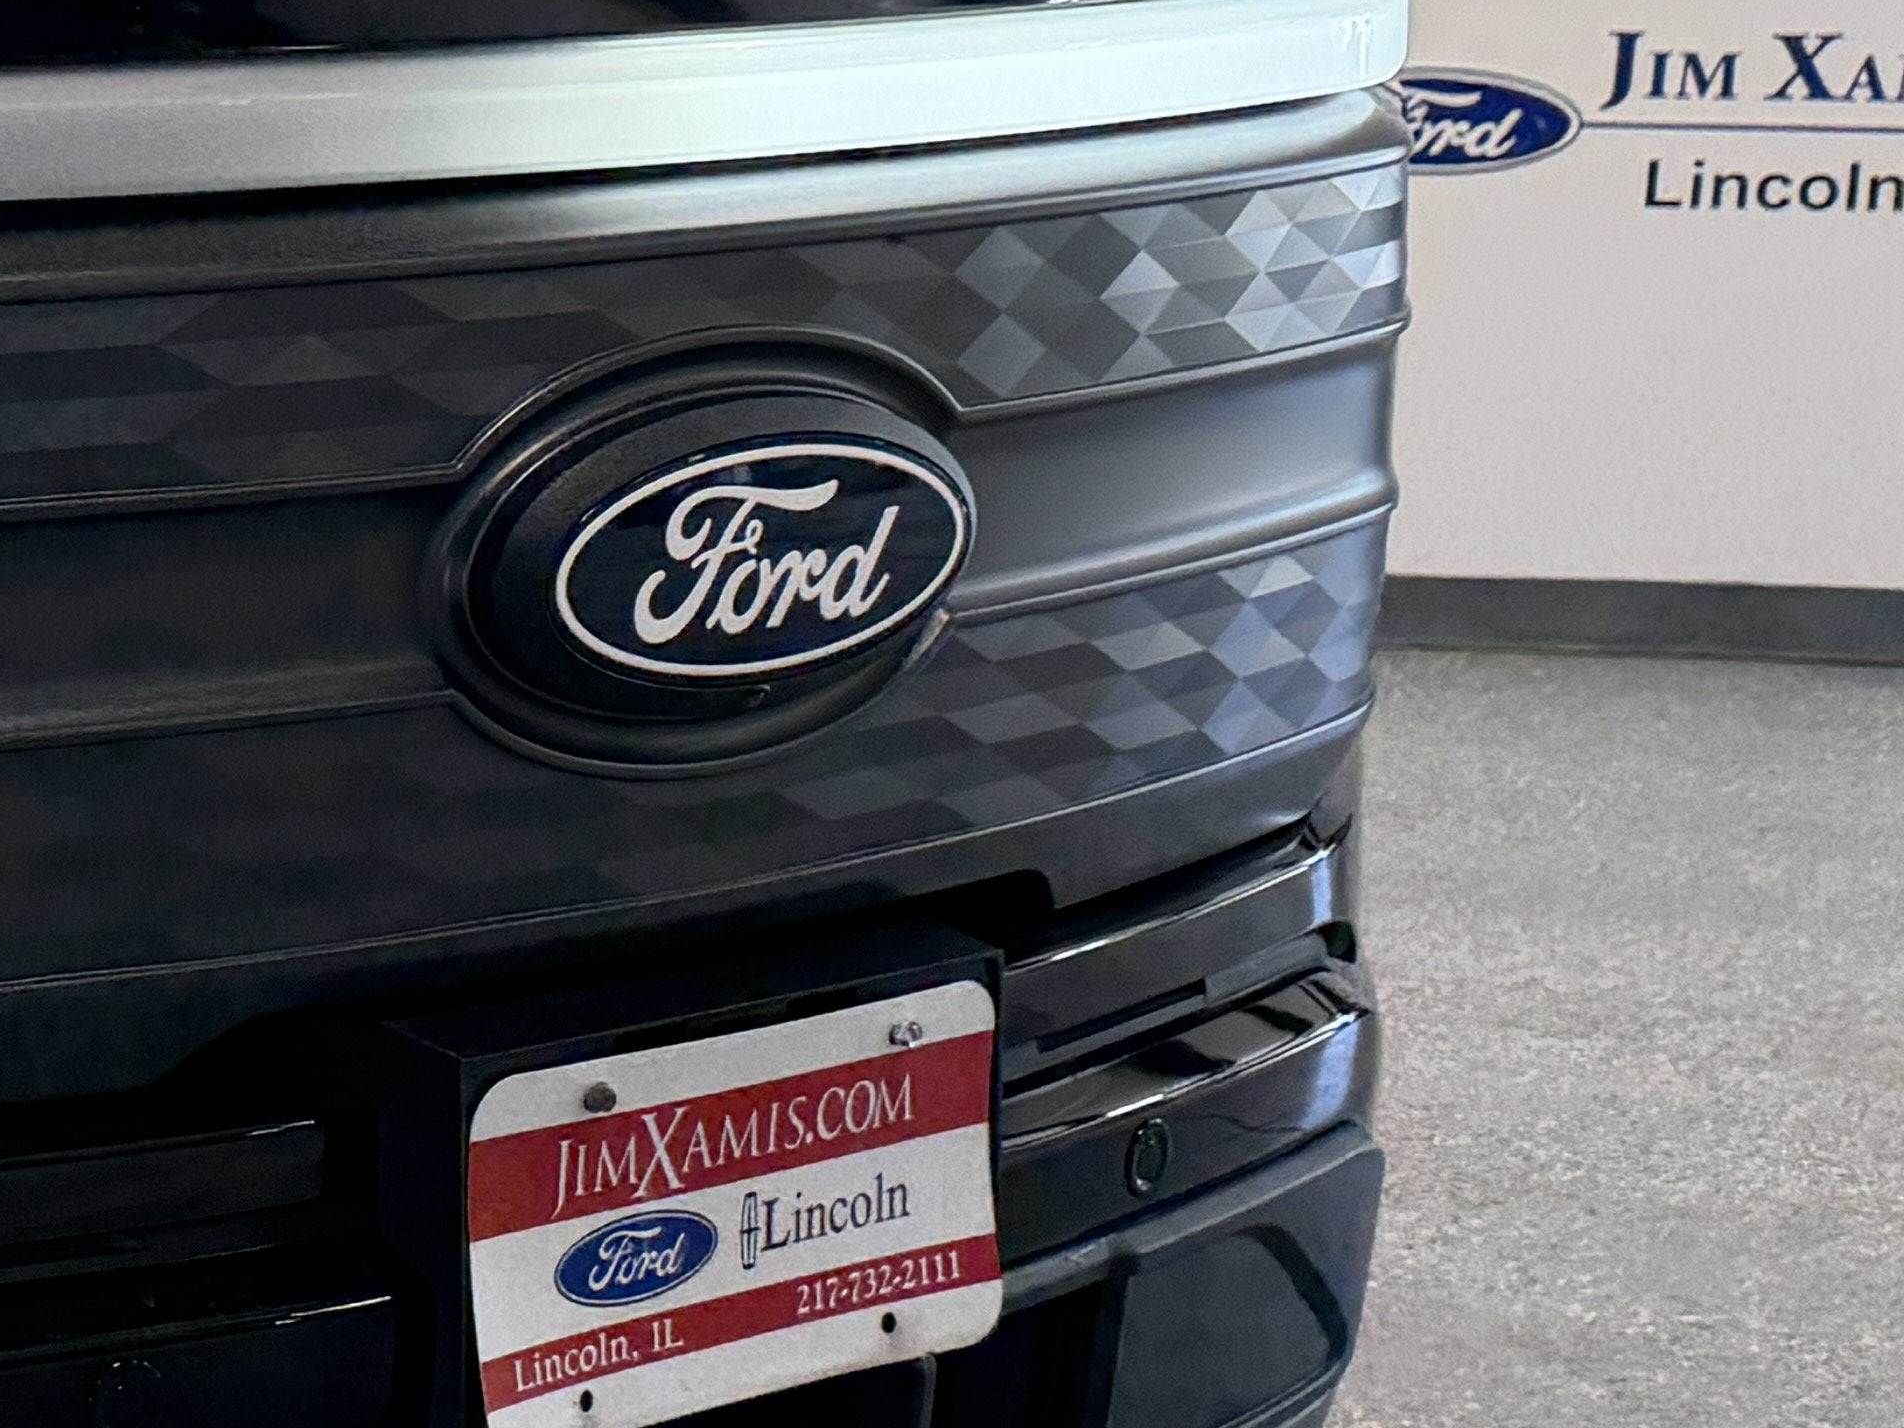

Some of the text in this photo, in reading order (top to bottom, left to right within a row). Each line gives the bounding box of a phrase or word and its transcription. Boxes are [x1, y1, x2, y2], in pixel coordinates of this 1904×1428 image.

[1600, 29, 1904, 111] JIM XA
[633, 478, 900, 646] Ford
[549, 1072, 915, 1220] JIMXAMIS.COM
[759, 1173, 910, 1253] Lincoln
[588, 1226, 686, 1292] Ford
[795, 1249, 962, 1316] 217-732-2111
[513, 1317, 685, 1394] Lincoln, IL
